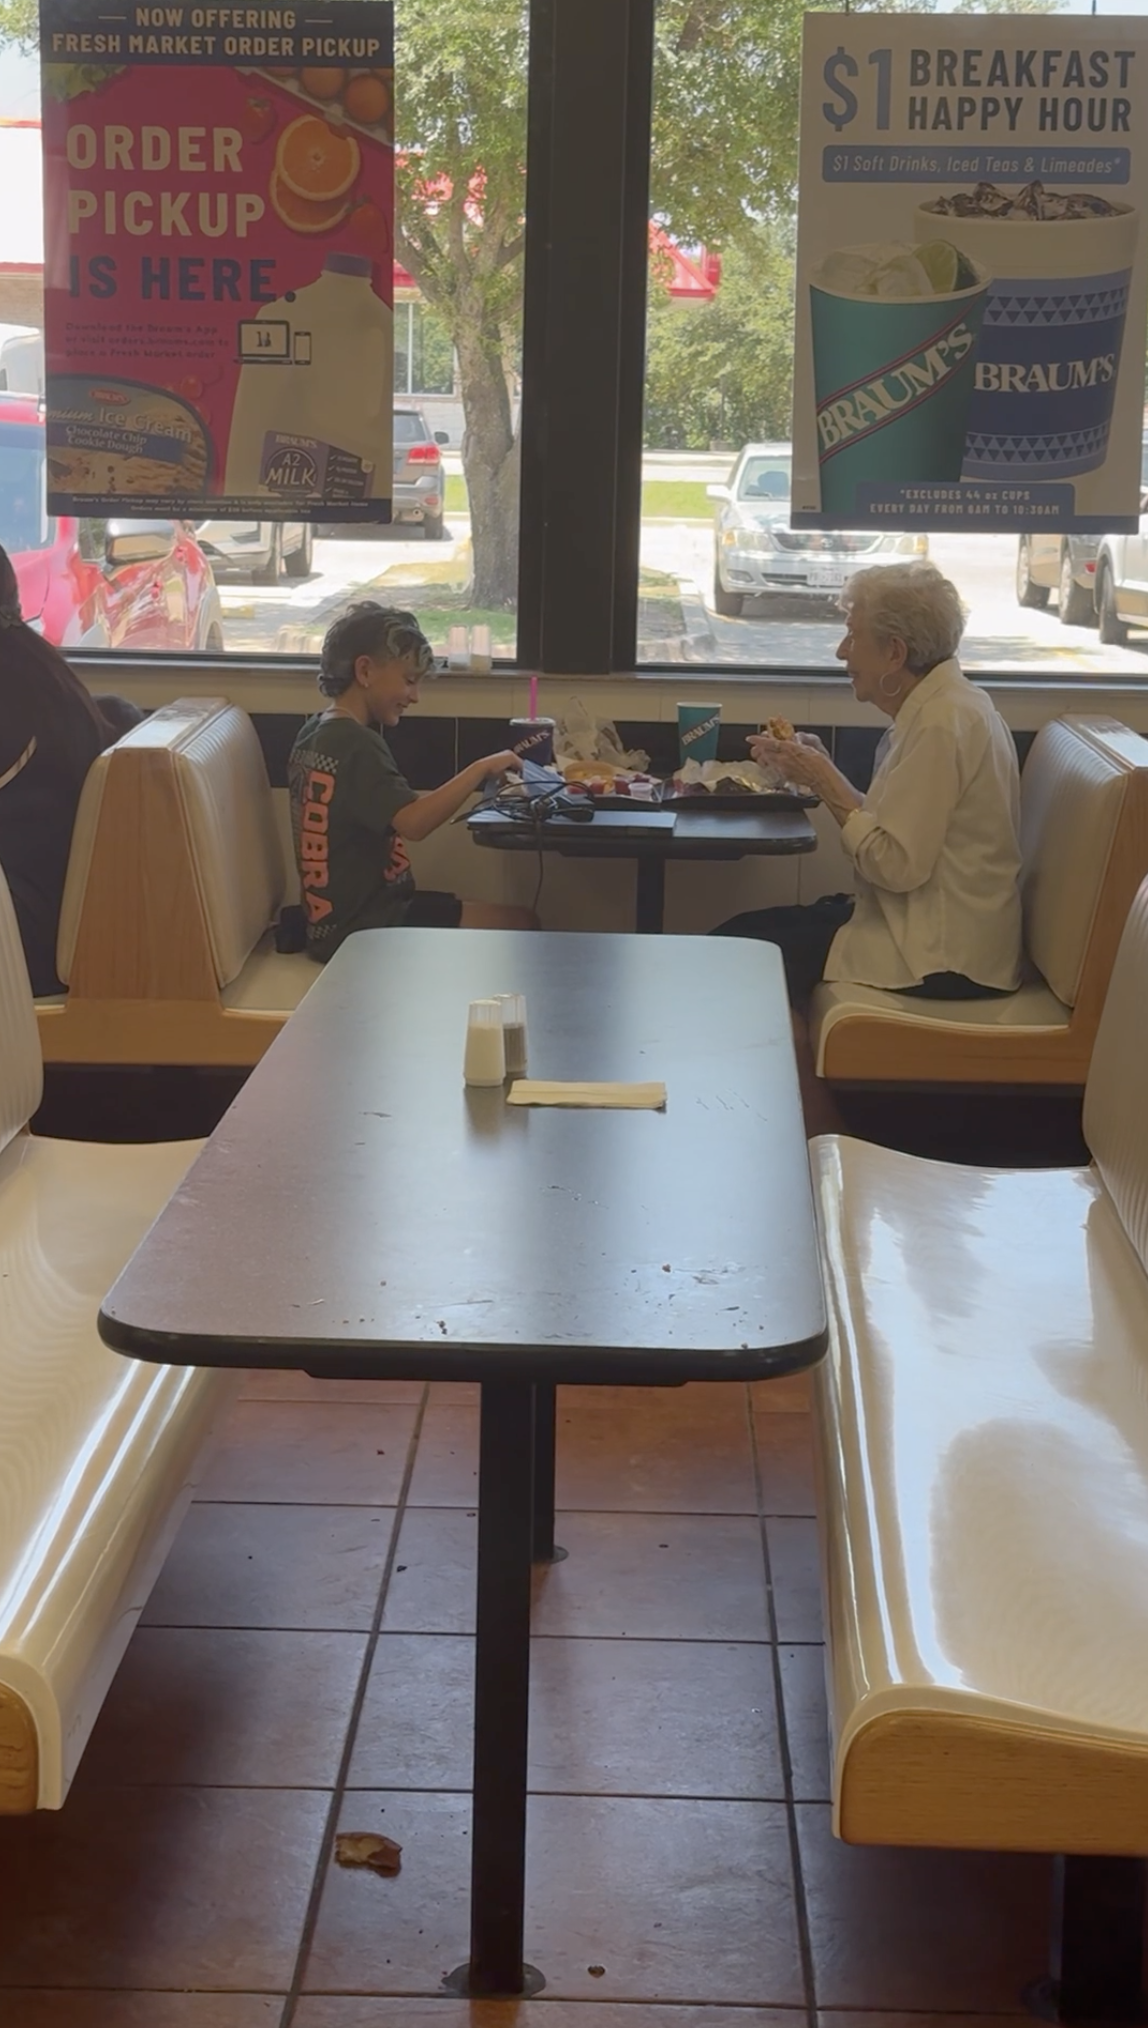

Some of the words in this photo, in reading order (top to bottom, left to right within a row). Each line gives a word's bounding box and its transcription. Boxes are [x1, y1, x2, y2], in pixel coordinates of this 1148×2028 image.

[136, 8, 183, 28] NOW
[191, 9, 296, 30] OFFERING
[53, 33, 121, 53] FRESH
[129, 35, 217, 55] MARKET
[224, 36, 294, 57] ORDER
[302, 38, 381, 58] PICKUP
[910, 49, 1136, 89] BREAKFAST
[822, 46, 892, 132] $1
[908, 96, 1024, 131] HAPPY
[1039, 97, 1132, 132] HOUR
[66, 124, 244, 172] ORDER
[833, 155, 849, 172] $1
[853, 155, 884, 172] Soft
[889, 155, 942, 175] Drinks,
[947, 156, 978, 173] Iced
[986, 157, 1019, 173] Teas
[1024, 157, 1035, 173] &
[68, 189, 266, 238] PICKUP
[68, 255, 118, 299] IS
[141, 256, 297, 303] HERE.
[817, 322, 974, 450] BRAUM'S
[973, 353, 1115, 393] BRAUM'S
[65, 425, 121, 442] Chocolate
[121, 432, 148, 445] Chip
[99, 407, 126, 426] Ice
[133, 414, 193, 444] Cream
[67, 435, 106, 448] Cookie
[106, 440, 144, 454] Dough
[281, 453, 301, 466] A2
[265, 467, 316, 487] MILK
[869, 503, 906, 514] EVERY
[909, 504, 931, 514] DAY
[934, 504, 964, 514] FROM
[1002, 490, 1031, 501] CUPS
[301, 769, 335, 924] COBRA
